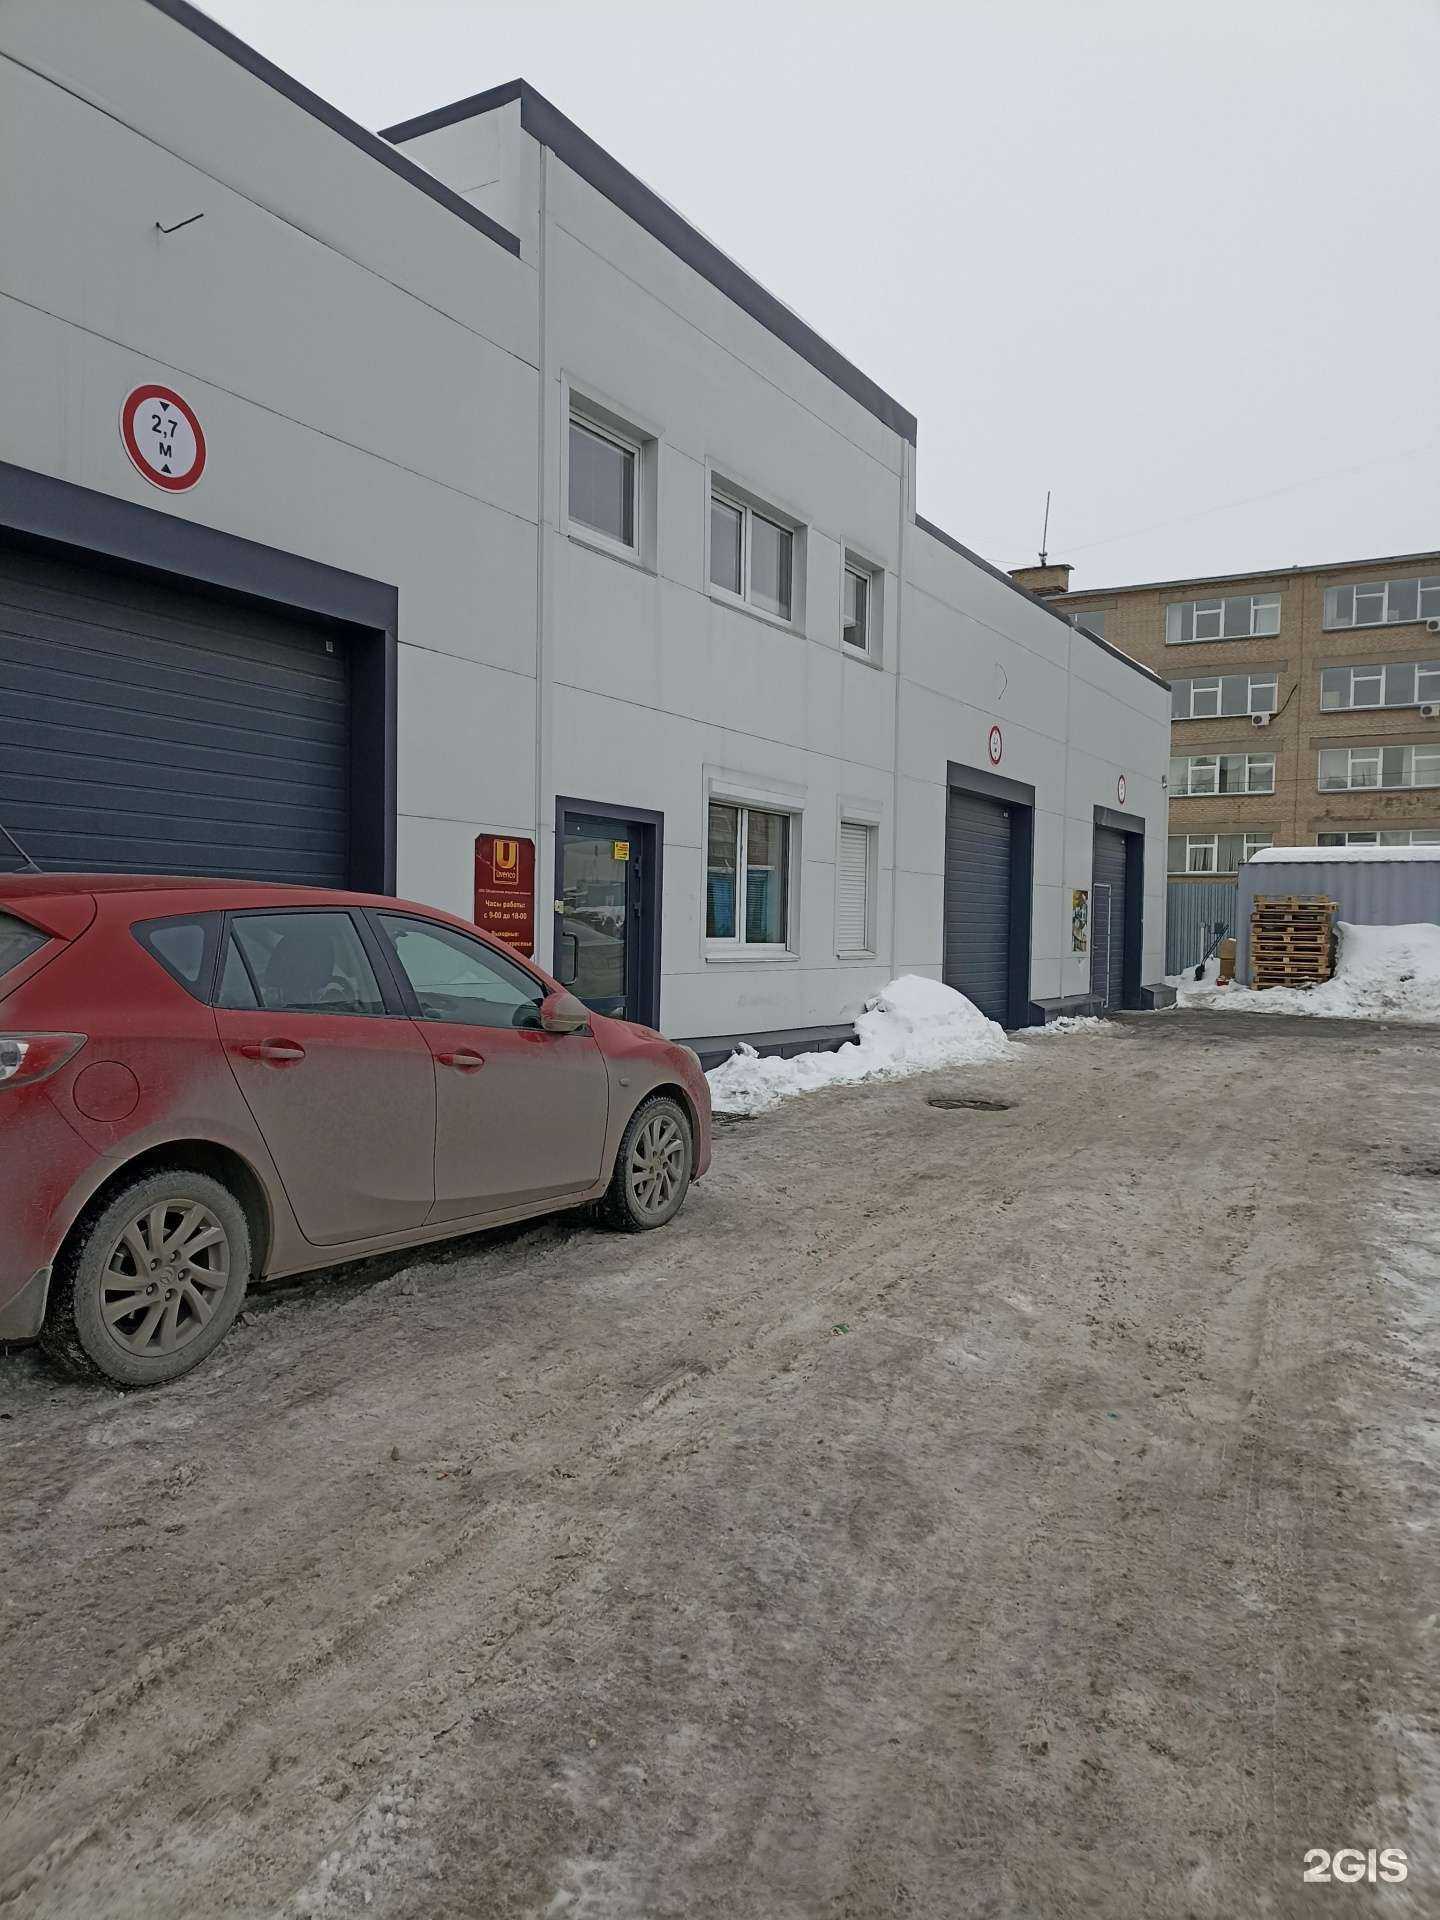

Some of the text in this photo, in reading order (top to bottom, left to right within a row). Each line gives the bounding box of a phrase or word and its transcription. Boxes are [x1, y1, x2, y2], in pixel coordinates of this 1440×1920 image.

[151, 414, 178, 439] 2,7
[489, 911, 502, 919] 9-00
[511, 912, 528, 920] 18-00
